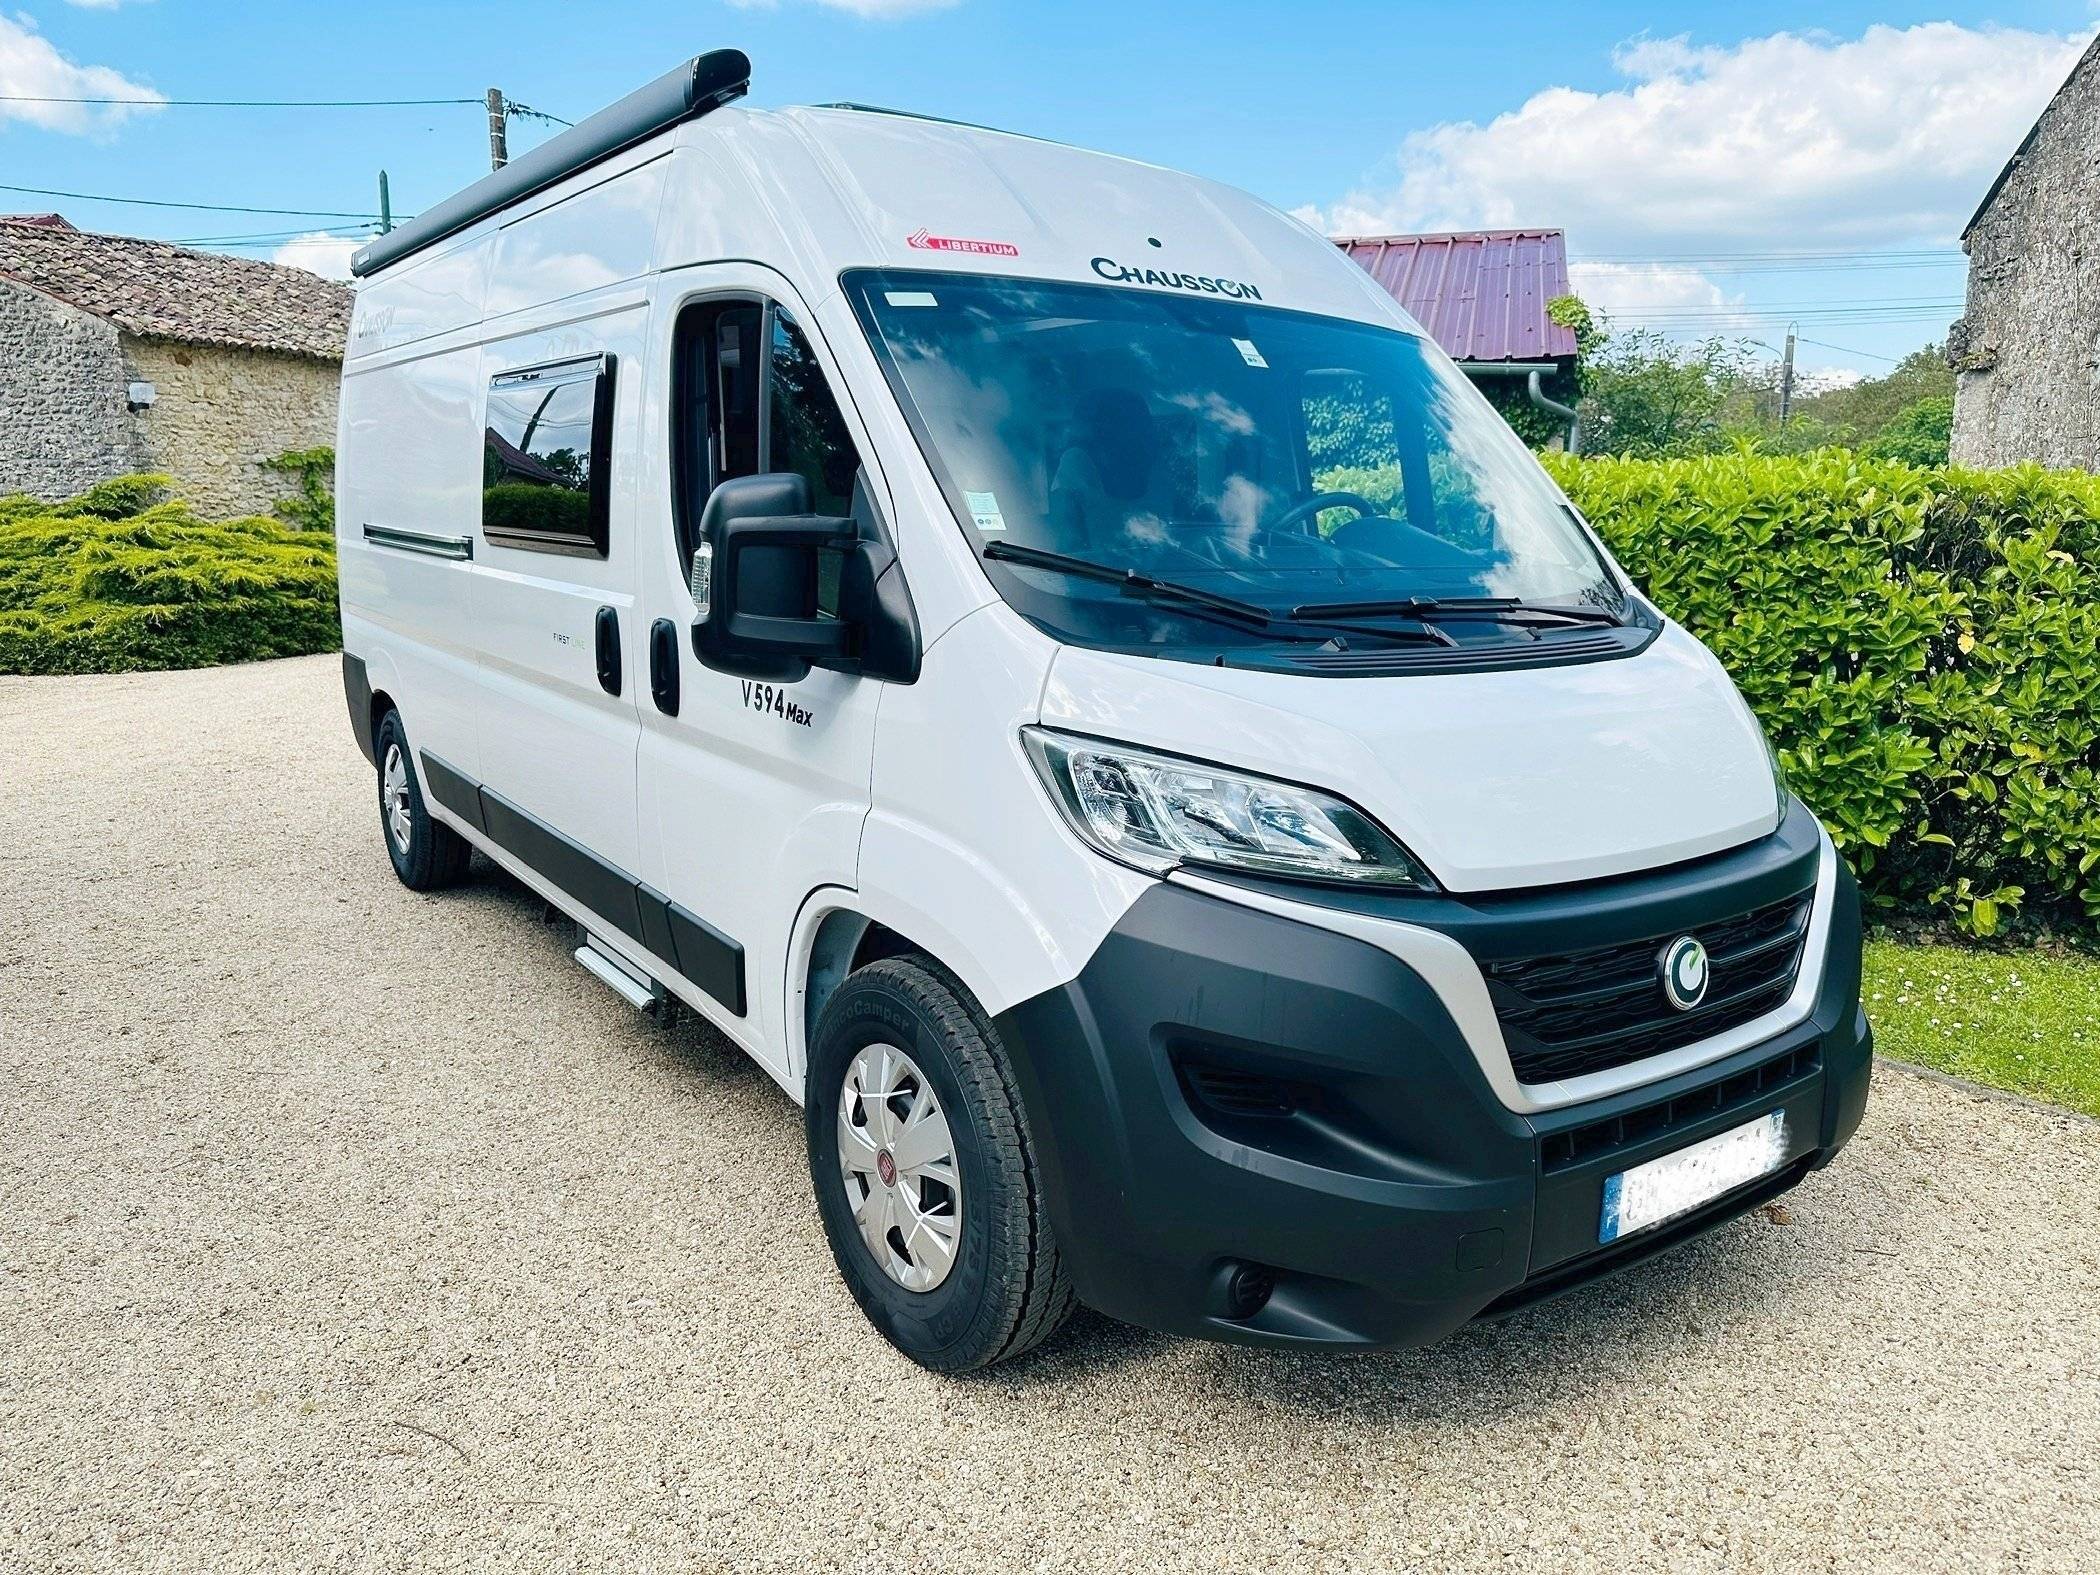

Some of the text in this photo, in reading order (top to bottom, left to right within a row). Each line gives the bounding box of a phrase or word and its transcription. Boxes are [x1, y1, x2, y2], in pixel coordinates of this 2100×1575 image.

[938, 239, 1015, 256] LIBERTIUM
[1090, 257, 1263, 300] CHAUSSON
[553, 632, 570, 646] FIRST
[741, 679, 814, 728] V 594 Max
[827, 1000, 910, 1037] ncoCamper
